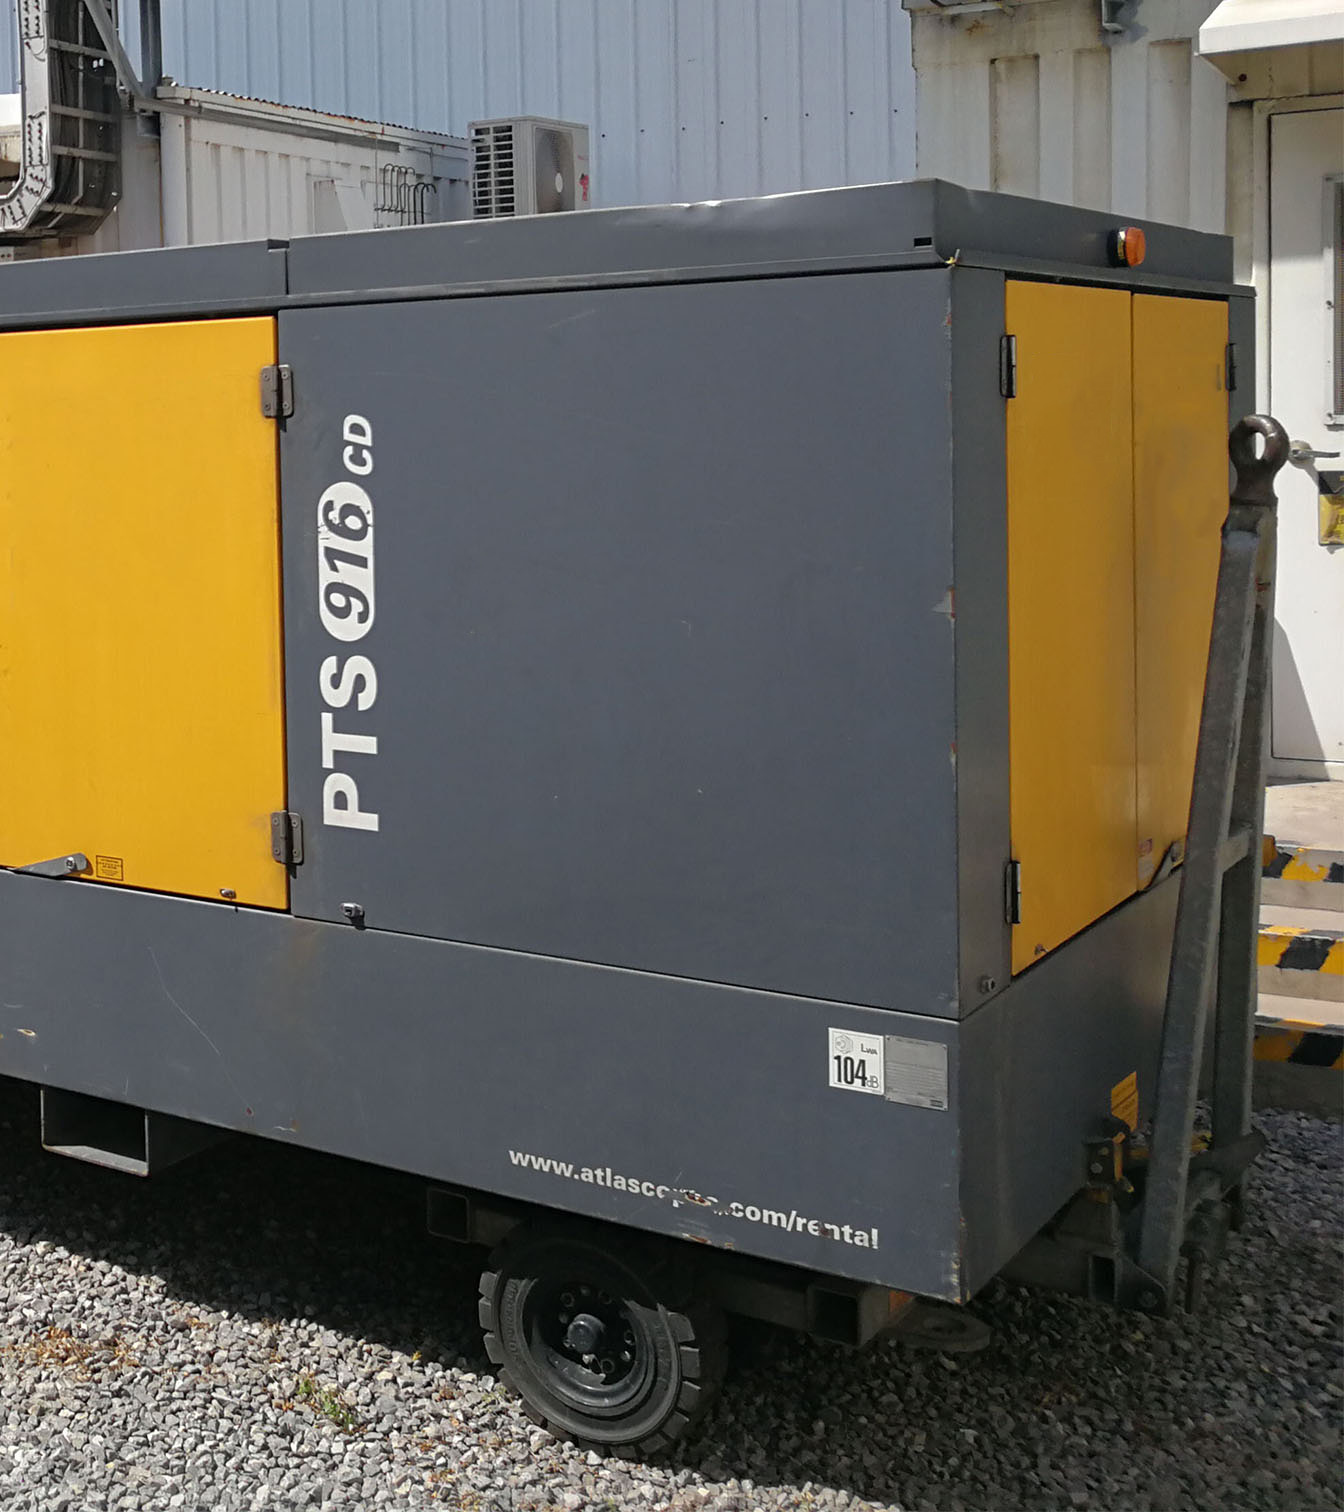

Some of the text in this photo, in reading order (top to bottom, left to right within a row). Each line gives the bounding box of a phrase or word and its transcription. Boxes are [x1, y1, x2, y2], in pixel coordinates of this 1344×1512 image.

[319, 414, 378, 831] PTS 916 CD
[834, 1055, 867, 1086] 104
[509, 1150, 878, 1249] www.atlascocom/rental
